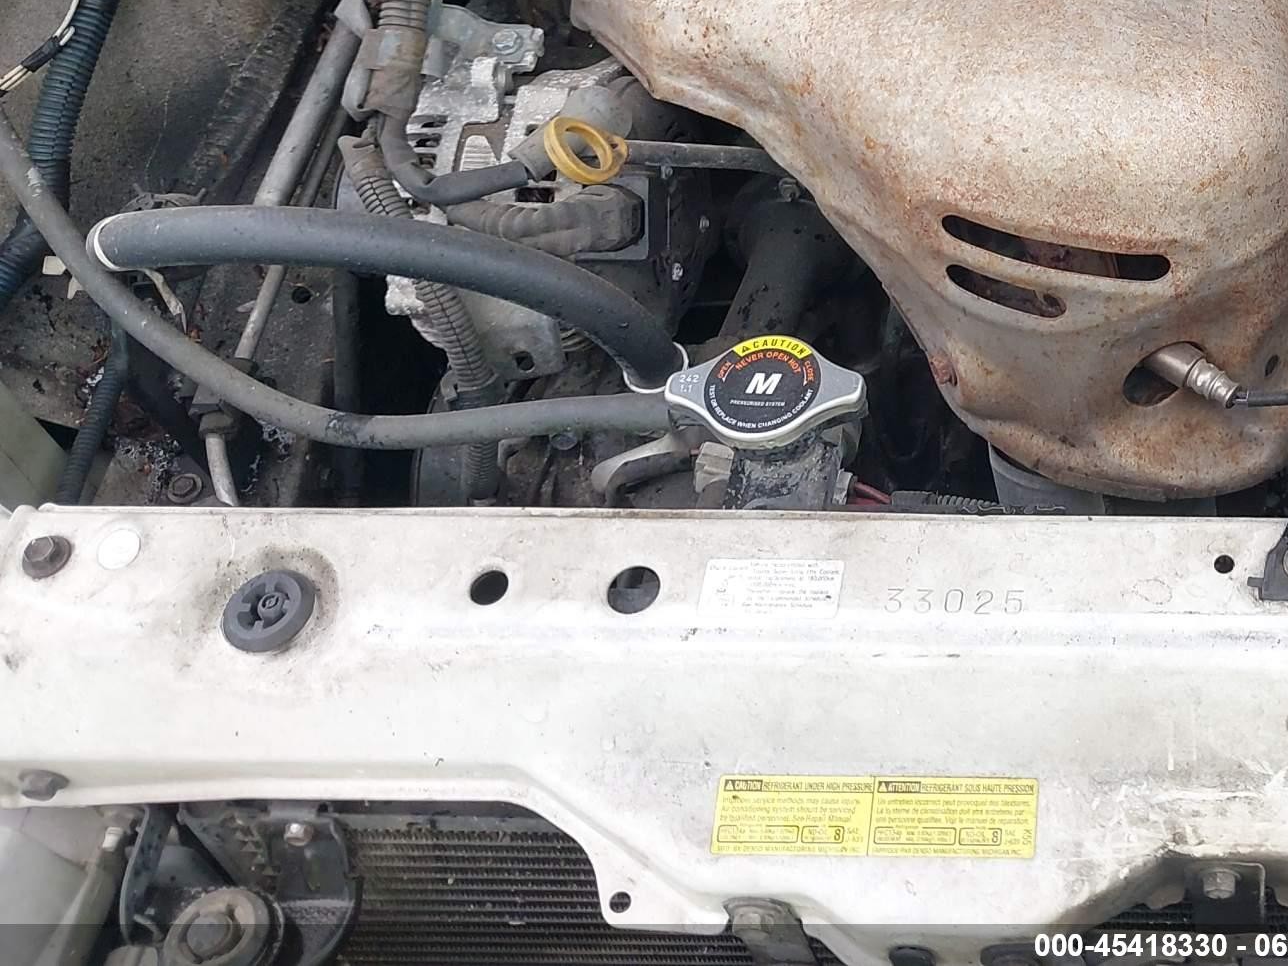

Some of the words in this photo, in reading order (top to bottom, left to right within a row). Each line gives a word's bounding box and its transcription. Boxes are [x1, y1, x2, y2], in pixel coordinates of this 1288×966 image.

[753, 338, 806, 355] CAUTION
[716, 360, 732, 379] OPEN
[734, 352, 765, 371] NEVER
[765, 350, 789, 363] OPEN
[787, 357, 802, 375] HOT
[804, 360, 815, 382] CLOSE
[679, 374, 700, 383] 242
[745, 372, 782, 395] M
[708, 384, 716, 400] TEST
[714, 406, 738, 426] REPLACE
[736, 420, 757, 429] WHEN
[757, 411, 793, 429] CHANGING
[792, 388, 814, 415] COOLANT
[884, 587, 1025, 615] 33025
[805, 781, 825, 791] UNDER
[842, 781, 873, 791] PRESSURE
[964, 783, 981, 792] SOUS
[982, 783, 1002, 792] HAUTE
